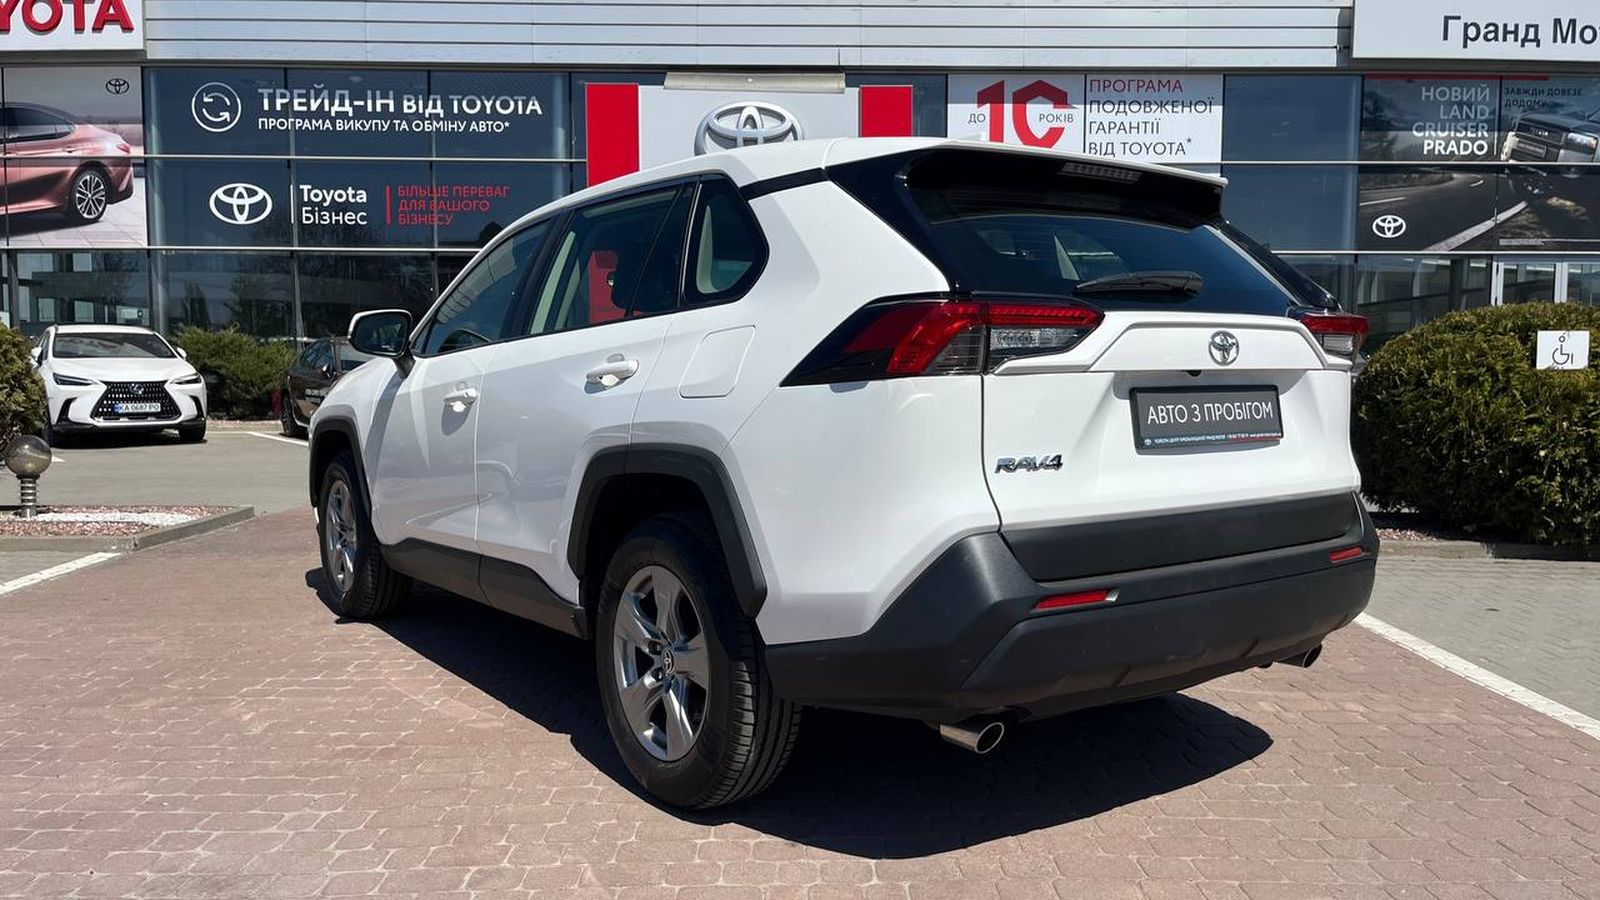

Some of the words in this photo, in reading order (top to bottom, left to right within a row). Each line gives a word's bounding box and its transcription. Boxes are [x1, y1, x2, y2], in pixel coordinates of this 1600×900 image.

[1442, 15, 1541, 49] Гранд
[1552, 18, 1600, 45] Мо
[1088, 79, 1184, 93] ПРОГРАМА
[1421, 84, 1490, 102] НОВИЙ
[1504, 87, 1545, 97] ЗАВЖДИ
[257, 83, 395, 117] ТРЕЙД-ІН
[402, 94, 444, 118] ВІД
[449, 95, 543, 115] TOYOTA
[1088, 96, 1215, 116] ПОДОВЖЕНОЇ
[968, 113, 986, 125] ДО
[1039, 113, 1075, 124] РОКІВ
[1440, 104, 1490, 120] LAND
[258, 117, 333, 131] ПРОГРАМА
[335, 119, 391, 132] ВИКУПУ
[393, 119, 410, 132] ТА
[412, 120, 467, 133] ОБМІНУ
[1088, 117, 1161, 135] ГАРАНТІЇ
[1412, 121, 1490, 138] CRUISER
[1088, 141, 1116, 158] ВІД
[1422, 139, 1489, 156] PRADO
[300, 184, 367, 206] Toyota
[397, 186, 449, 198] БІЛЬШЕ
[452, 186, 510, 198] ПЕРЕВАГ
[397, 200, 426, 212] ДЛЯ
[429, 200, 491, 212] ВАШОГО
[302, 206, 368, 225] Бізнес
[397, 213, 454, 226] БІЗНЕСУ
[1147, 404, 1188, 425] АВТО
[1203, 401, 1275, 422] ПРОБІГОМ
[994, 453, 1063, 474] RAV4
